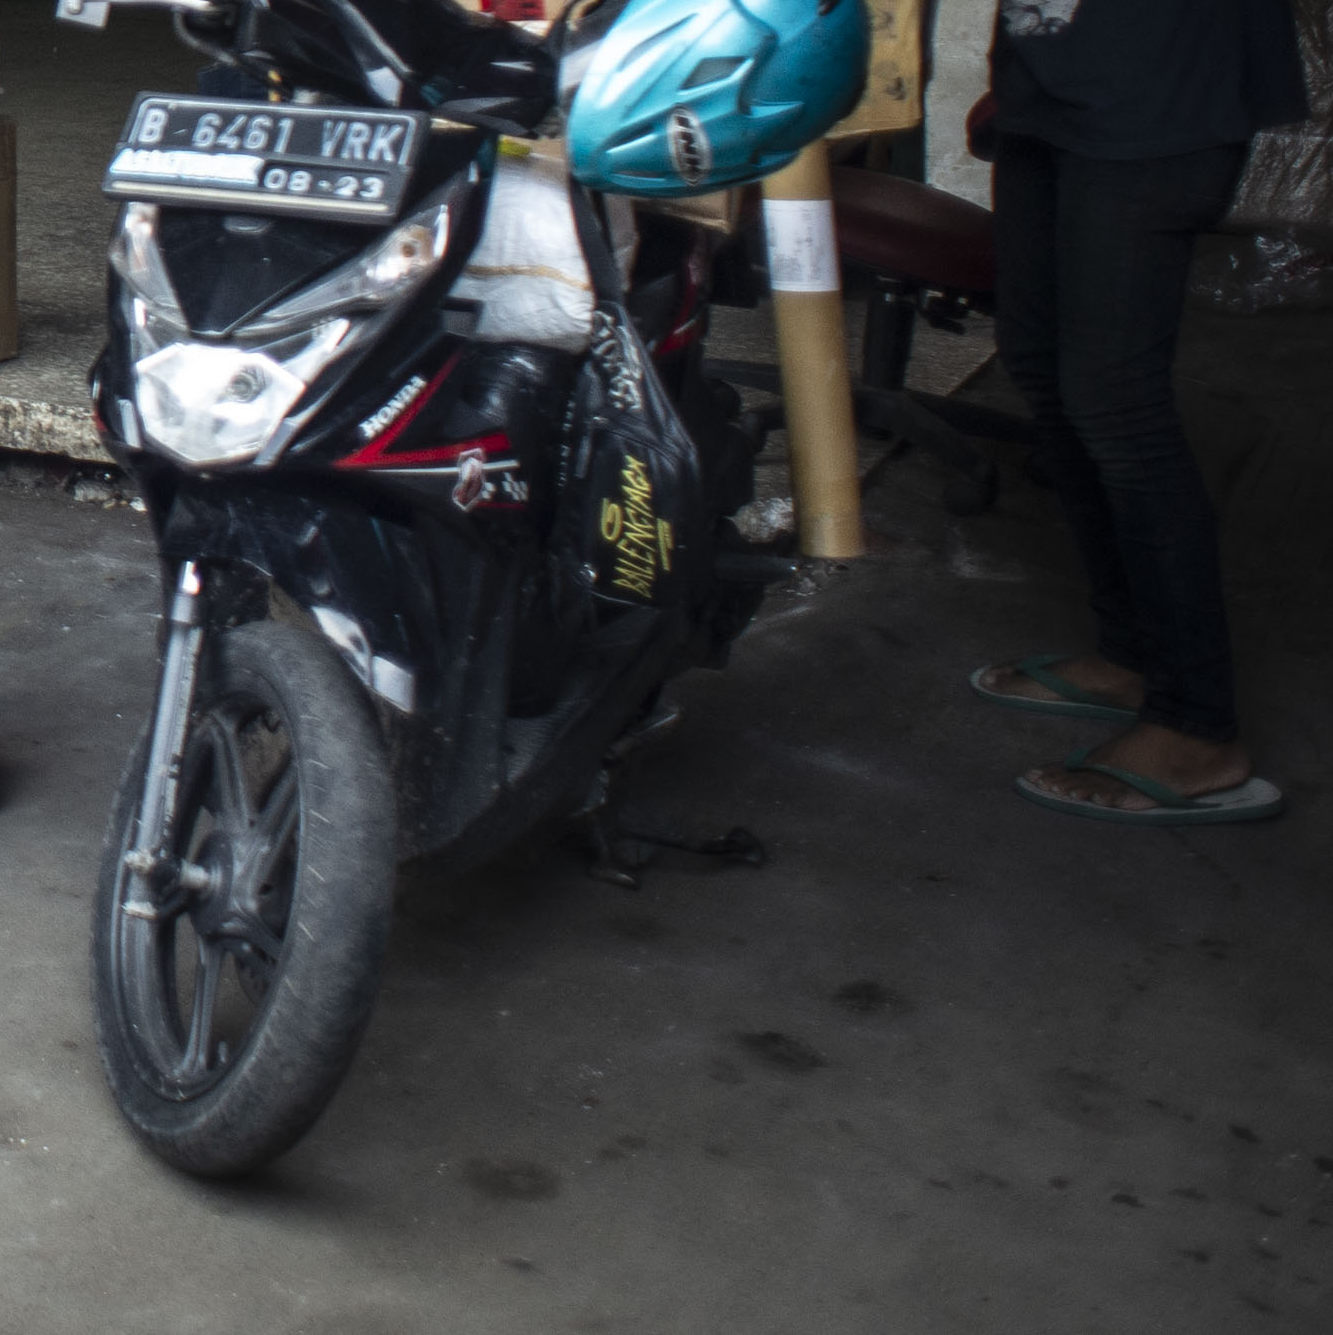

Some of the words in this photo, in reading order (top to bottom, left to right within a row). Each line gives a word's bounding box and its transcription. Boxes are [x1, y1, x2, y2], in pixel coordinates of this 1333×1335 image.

[137, 107, 170, 144] B
[191, 112, 295, 154] 6461
[321, 119, 406, 163] VRK
[358, 375, 428, 440] HONDA
